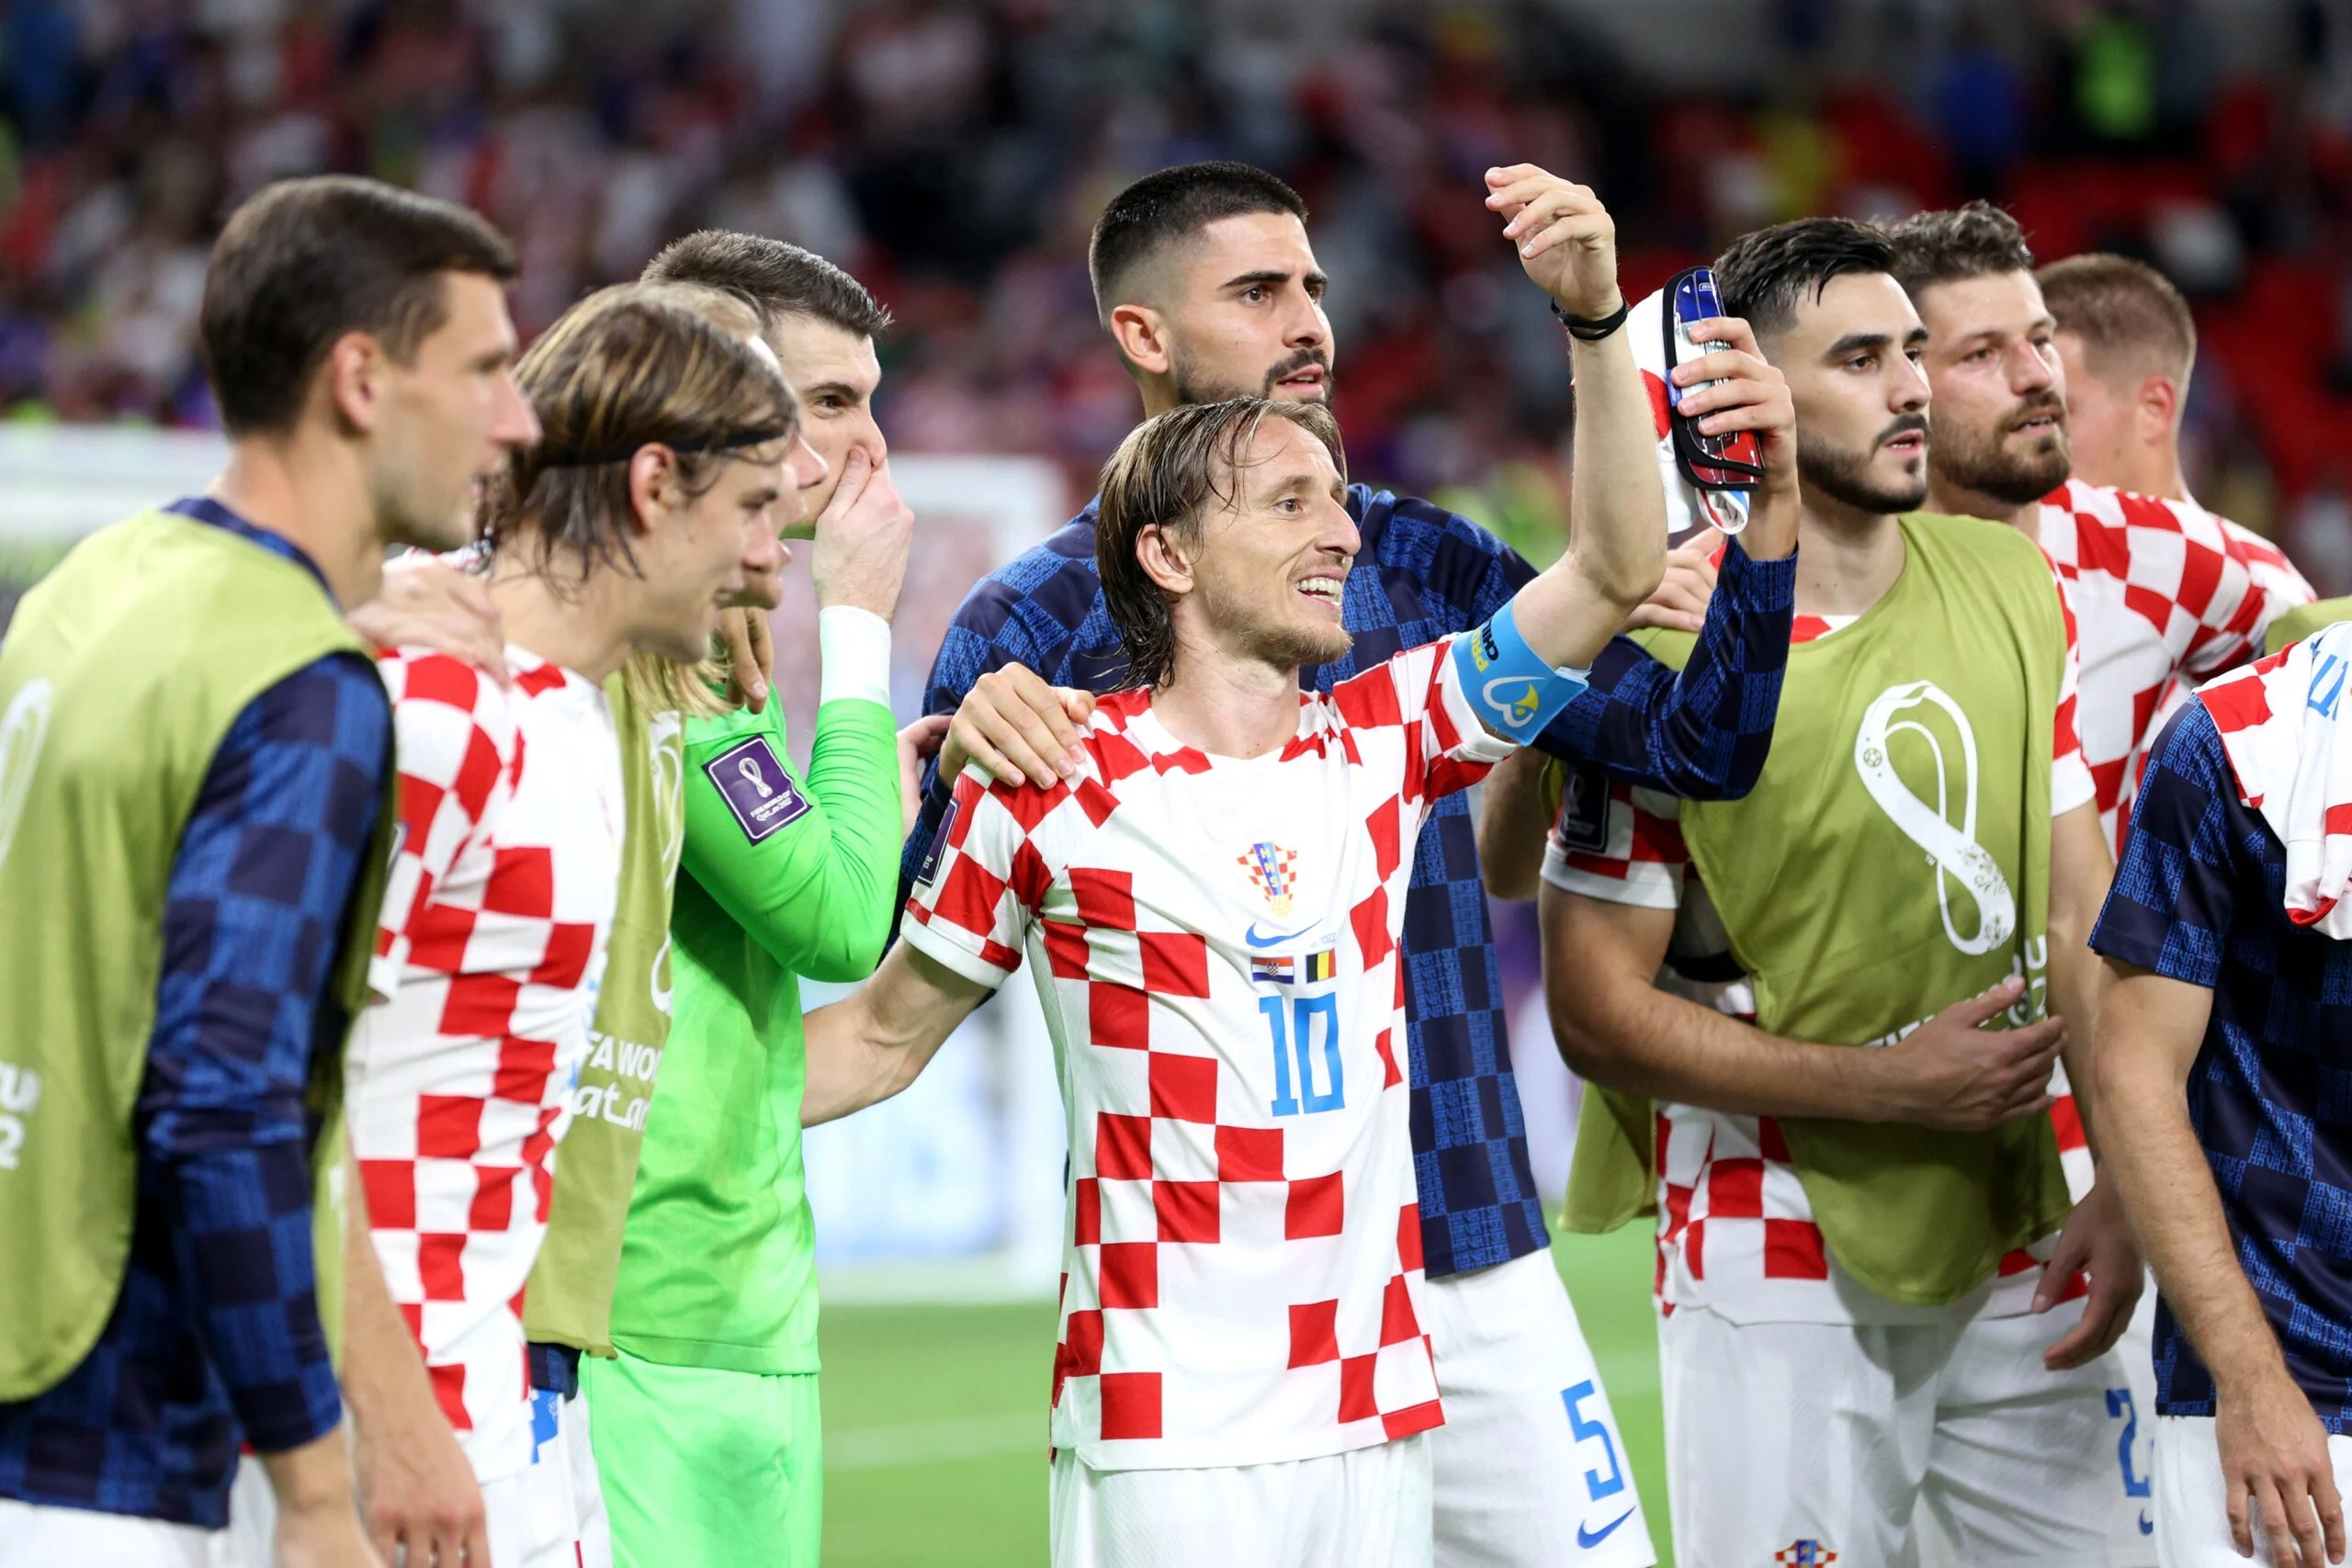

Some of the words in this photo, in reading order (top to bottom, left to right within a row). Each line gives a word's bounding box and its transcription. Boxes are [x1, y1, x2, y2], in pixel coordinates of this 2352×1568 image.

[1259, 992, 1345, 1117] 10
[1560, 1380, 1624, 1502] 5
[2106, 1389, 2154, 1498] 2
